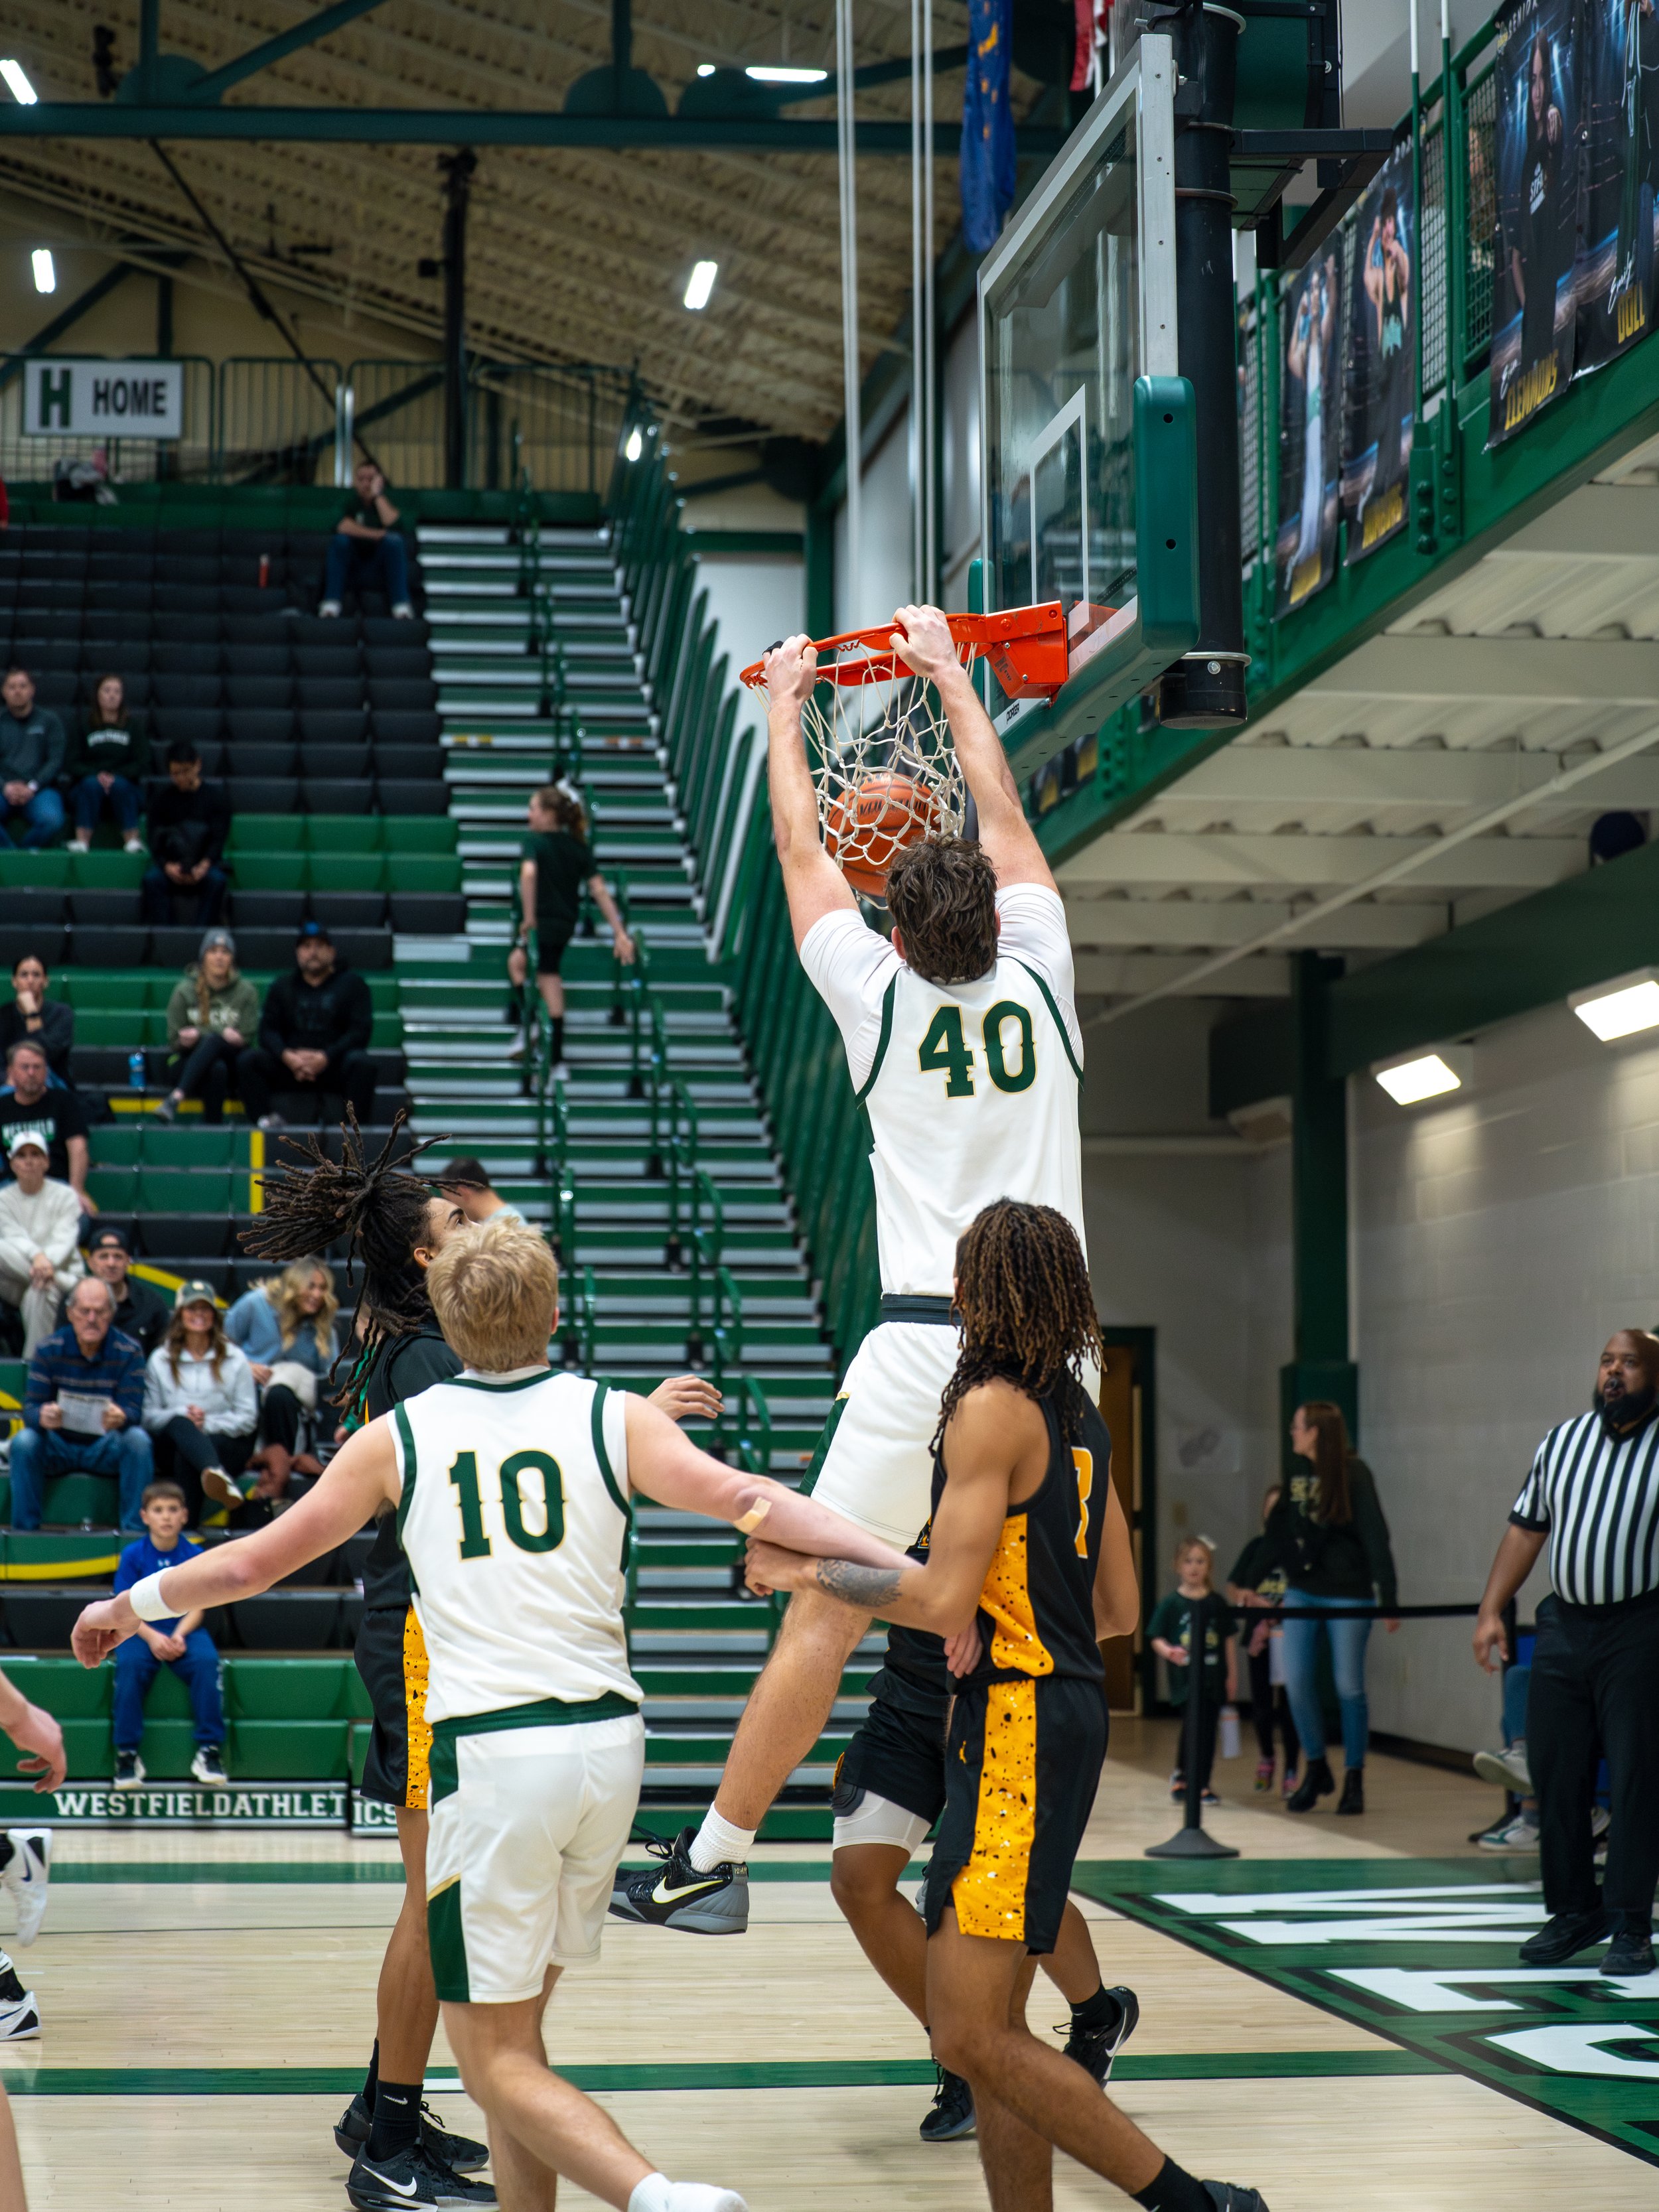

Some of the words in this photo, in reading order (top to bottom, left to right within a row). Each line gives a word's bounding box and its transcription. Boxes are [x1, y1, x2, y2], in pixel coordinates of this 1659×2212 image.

[39, 368, 71, 428] H
[92, 378, 167, 417] HOME
[918, 999, 1037, 1099] 40
[448, 1449, 568, 1561] 10
